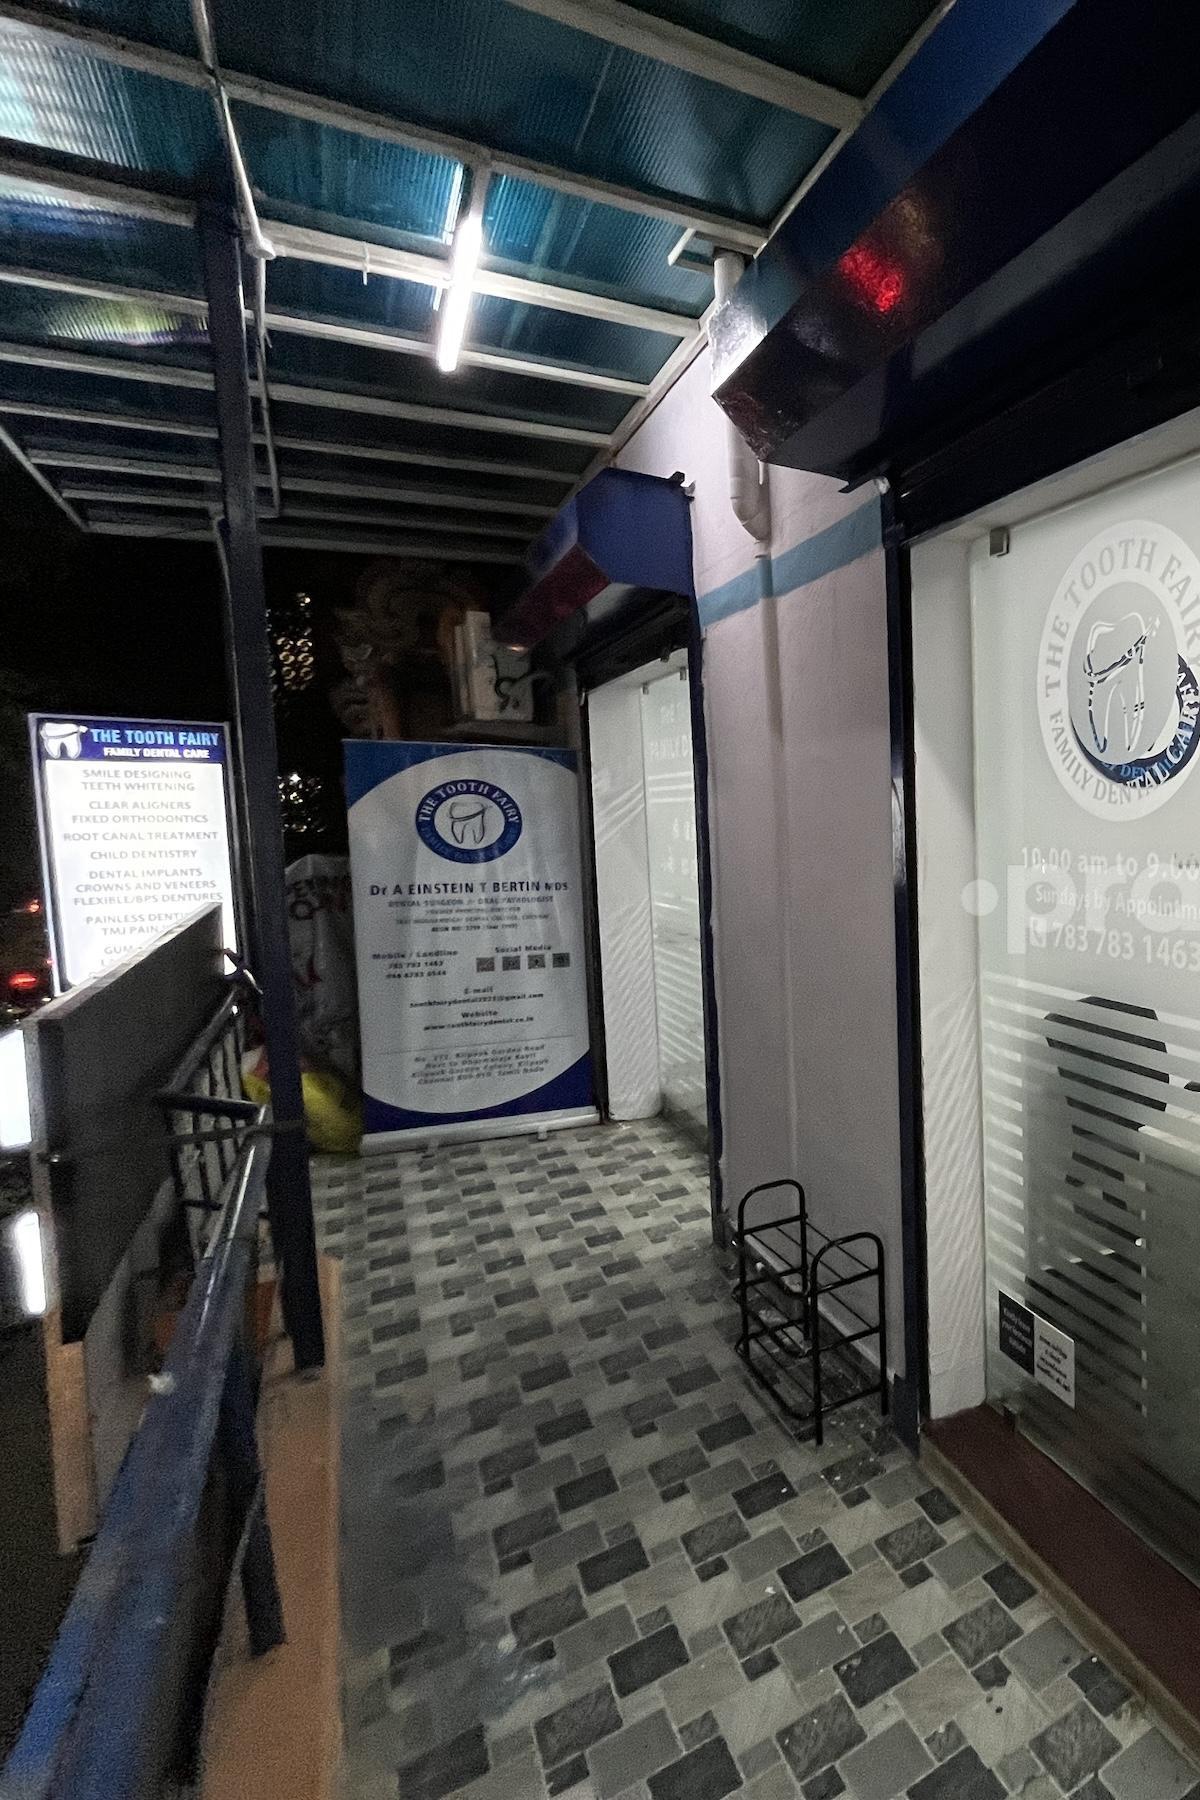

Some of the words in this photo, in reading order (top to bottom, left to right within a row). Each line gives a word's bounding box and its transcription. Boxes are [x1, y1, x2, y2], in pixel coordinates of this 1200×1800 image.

[1045, 615, 1069, 697] THE
[1064, 538, 1158, 608] TOOTH
[90, 728, 121, 743] THE
[125, 730, 174, 745] TOOTH
[178, 732, 219, 746] FAIRY
[104, 747, 140, 757] FAMILY
[143, 748, 181, 758] DENTAL
[183, 749, 210, 759] CARE
[1050, 711, 1094, 790] FAMILY
[82, 769, 121, 779] SMILE
[124, 770, 192, 780] DESIGNING
[81, 781, 121, 791] TEETH
[124, 782, 195, 792] WHITENING
[89, 801, 128, 810] CLEAR
[132, 801, 192, 810] ALIGNERS
[419, 797, 438, 821] THE
[435, 782, 489, 798] TOOTH
[492, 789, 519, 823] FAIRY
[72, 815, 109, 824] FIXED
[112, 815, 209, 824] ORTHODONTICS
[63, 832, 99, 842] ROOT
[102, 832, 147, 841] CANAL
[150, 831, 219, 840] TREATMENT
[90, 850, 128, 860] CHILD
[131, 850, 198, 859] DENTISTRY
[1078, 854, 1108, 874] am
[1116, 852, 1138, 876] to
[89, 870, 138, 880] DENTAL
[141, 868, 203, 877] IMPLANTS
[76, 883, 132, 893] CROWNS
[135, 881, 161, 891] AND
[164, 880, 217, 890] VENEERS
[393, 883, 403, 895] A
[408, 882, 474, 895] EINSTEIN
[480, 882, 487, 893] T
[493, 881, 540, 893] BERTIN
[161, 892, 224, 903] DENTURES
[86, 914, 145, 925] PAINLESS
[102, 927, 126, 937] TMJ
[129, 925, 159, 936] PAIN
[1052, 922, 1089, 952] 783
[1095, 928, 1135, 961] 783
[461, 1010, 498, 1019] Website
